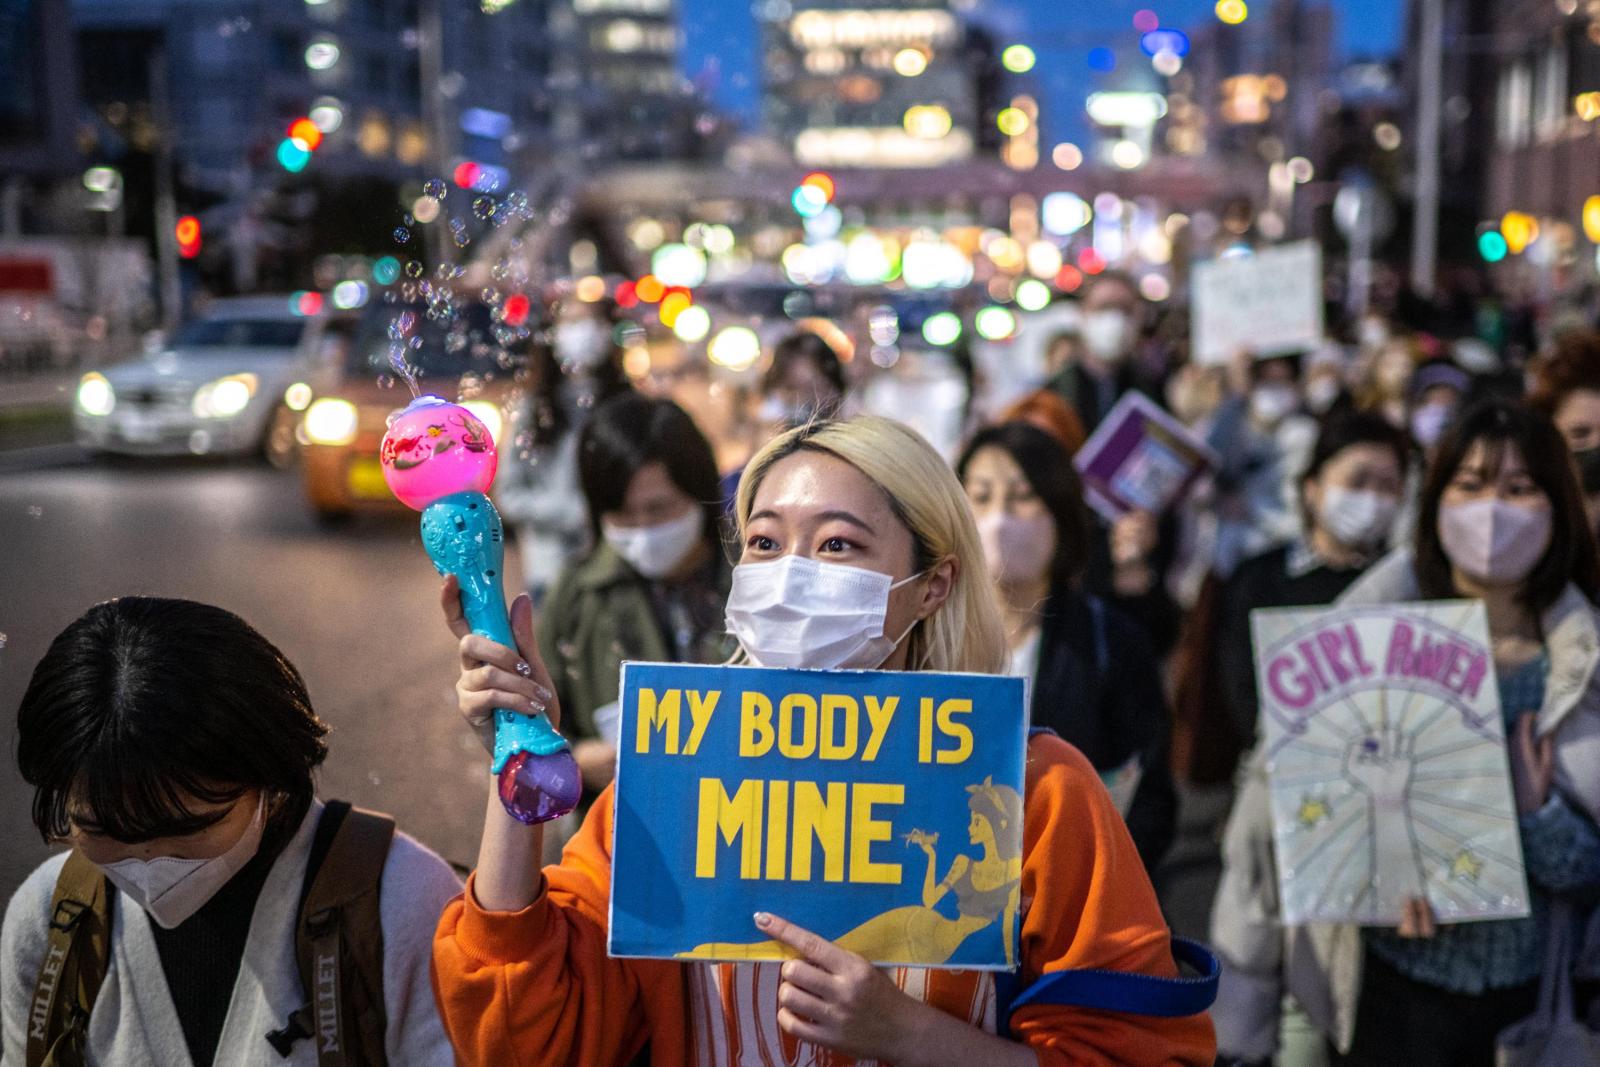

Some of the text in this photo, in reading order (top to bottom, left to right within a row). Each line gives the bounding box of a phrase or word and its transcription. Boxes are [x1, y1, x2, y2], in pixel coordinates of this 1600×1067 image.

[1267, 623, 1374, 707] GIRL
[635, 688, 974, 764] MY BODY IS
[695, 777, 905, 885] MINE
[31, 945, 65, 1041] MILLET
[317, 954, 339, 1052] MILLET
